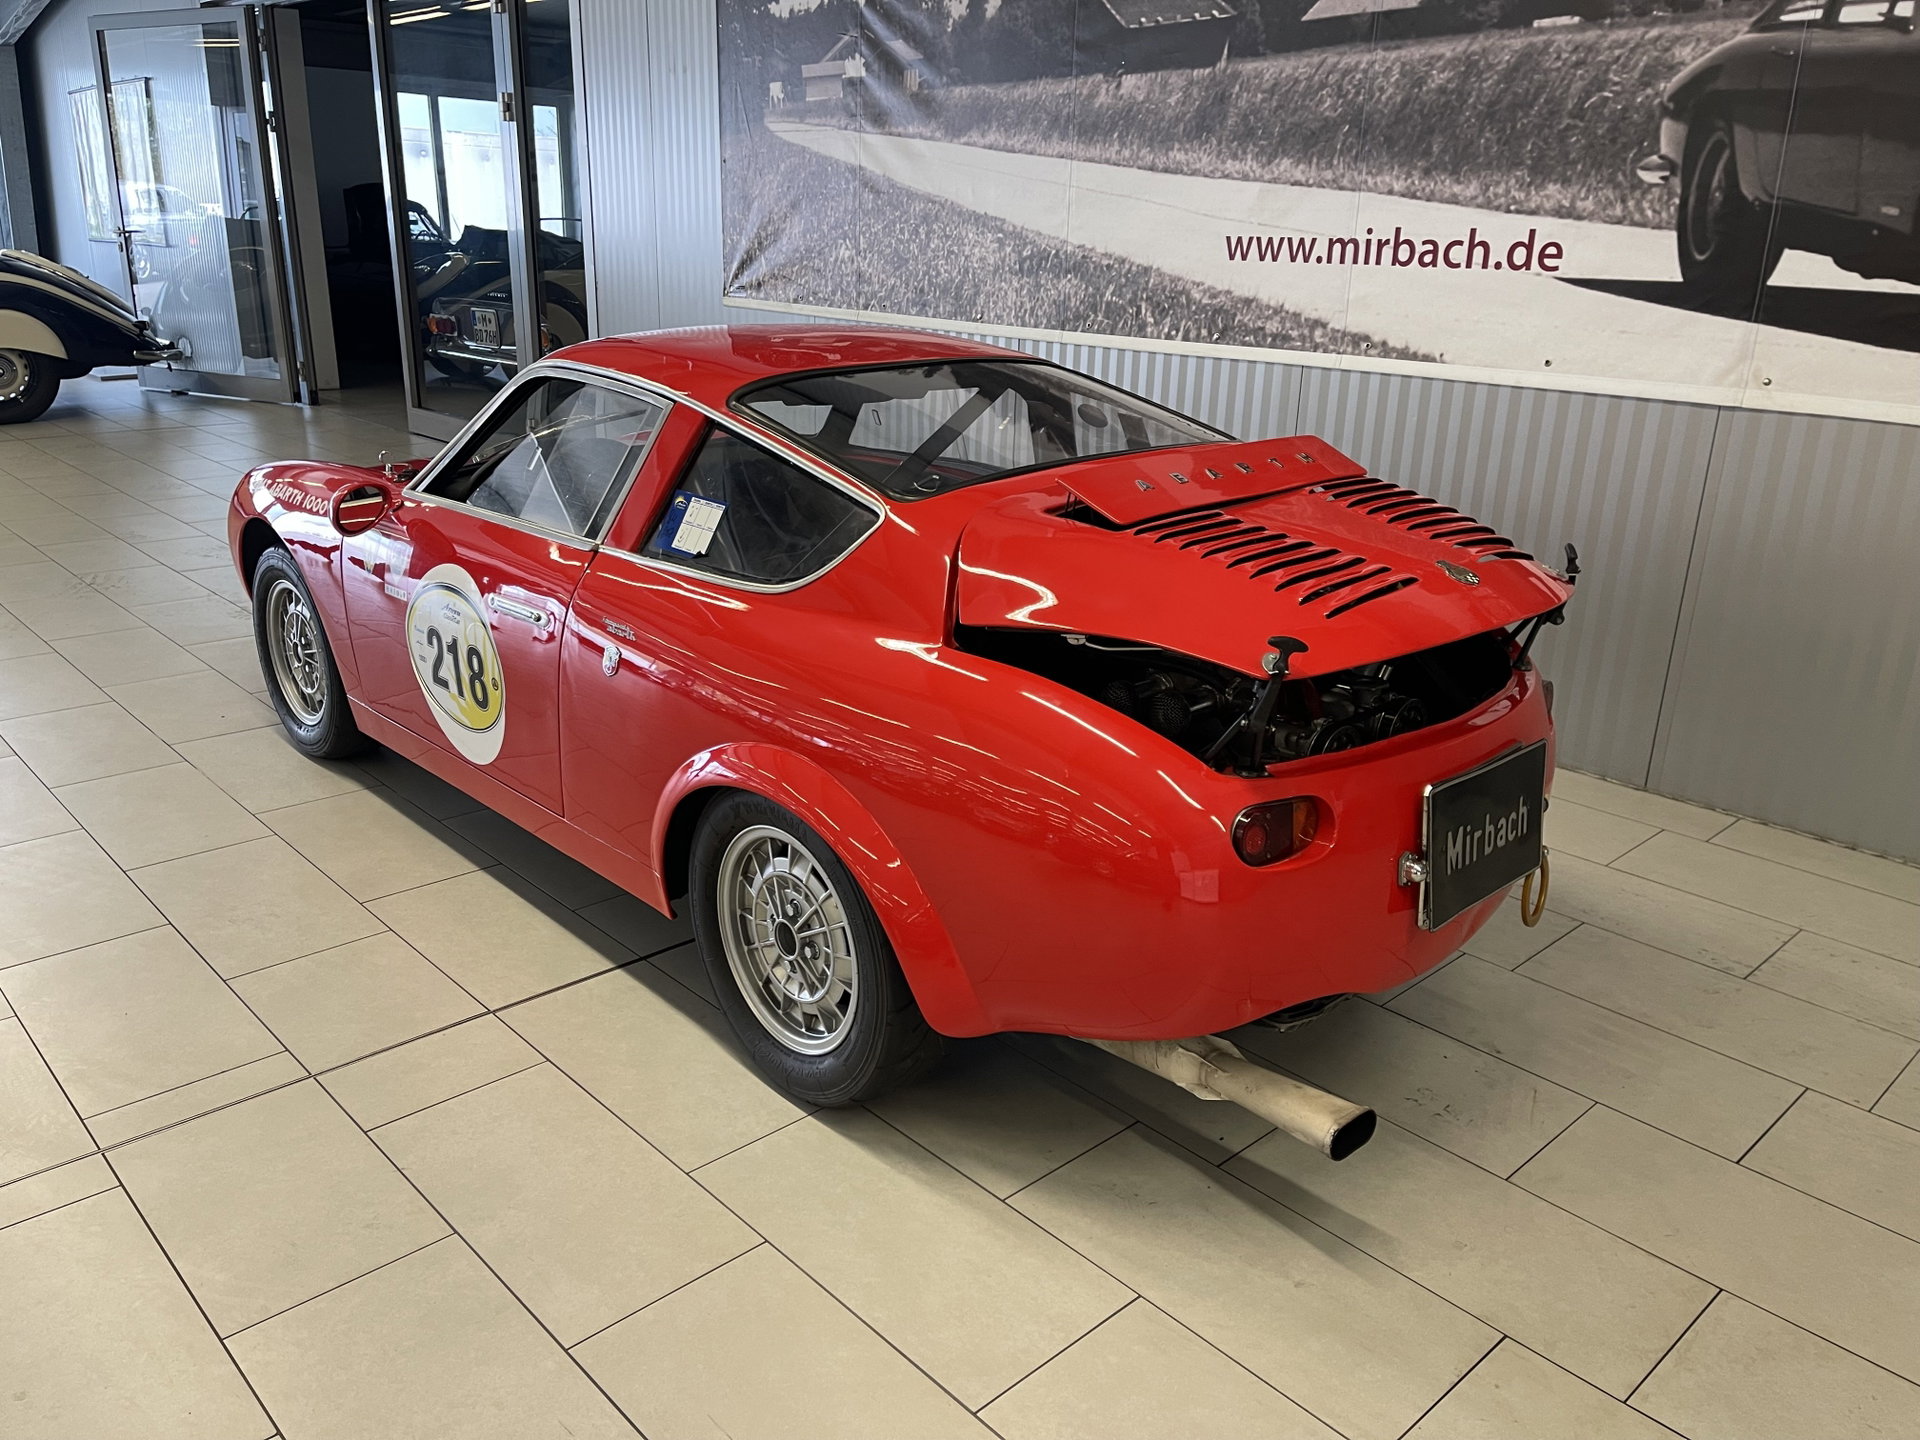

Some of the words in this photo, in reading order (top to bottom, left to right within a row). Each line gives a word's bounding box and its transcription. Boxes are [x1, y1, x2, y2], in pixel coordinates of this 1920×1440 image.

[1225, 227, 1564, 272] www.mirbach.de
[1135, 452, 1316, 492] ABARTH
[269, 482, 305, 506] ABARTH
[302, 494, 329, 515] 1000
[427, 625, 489, 712] 218
[1446, 795, 1529, 876] Mirbach
